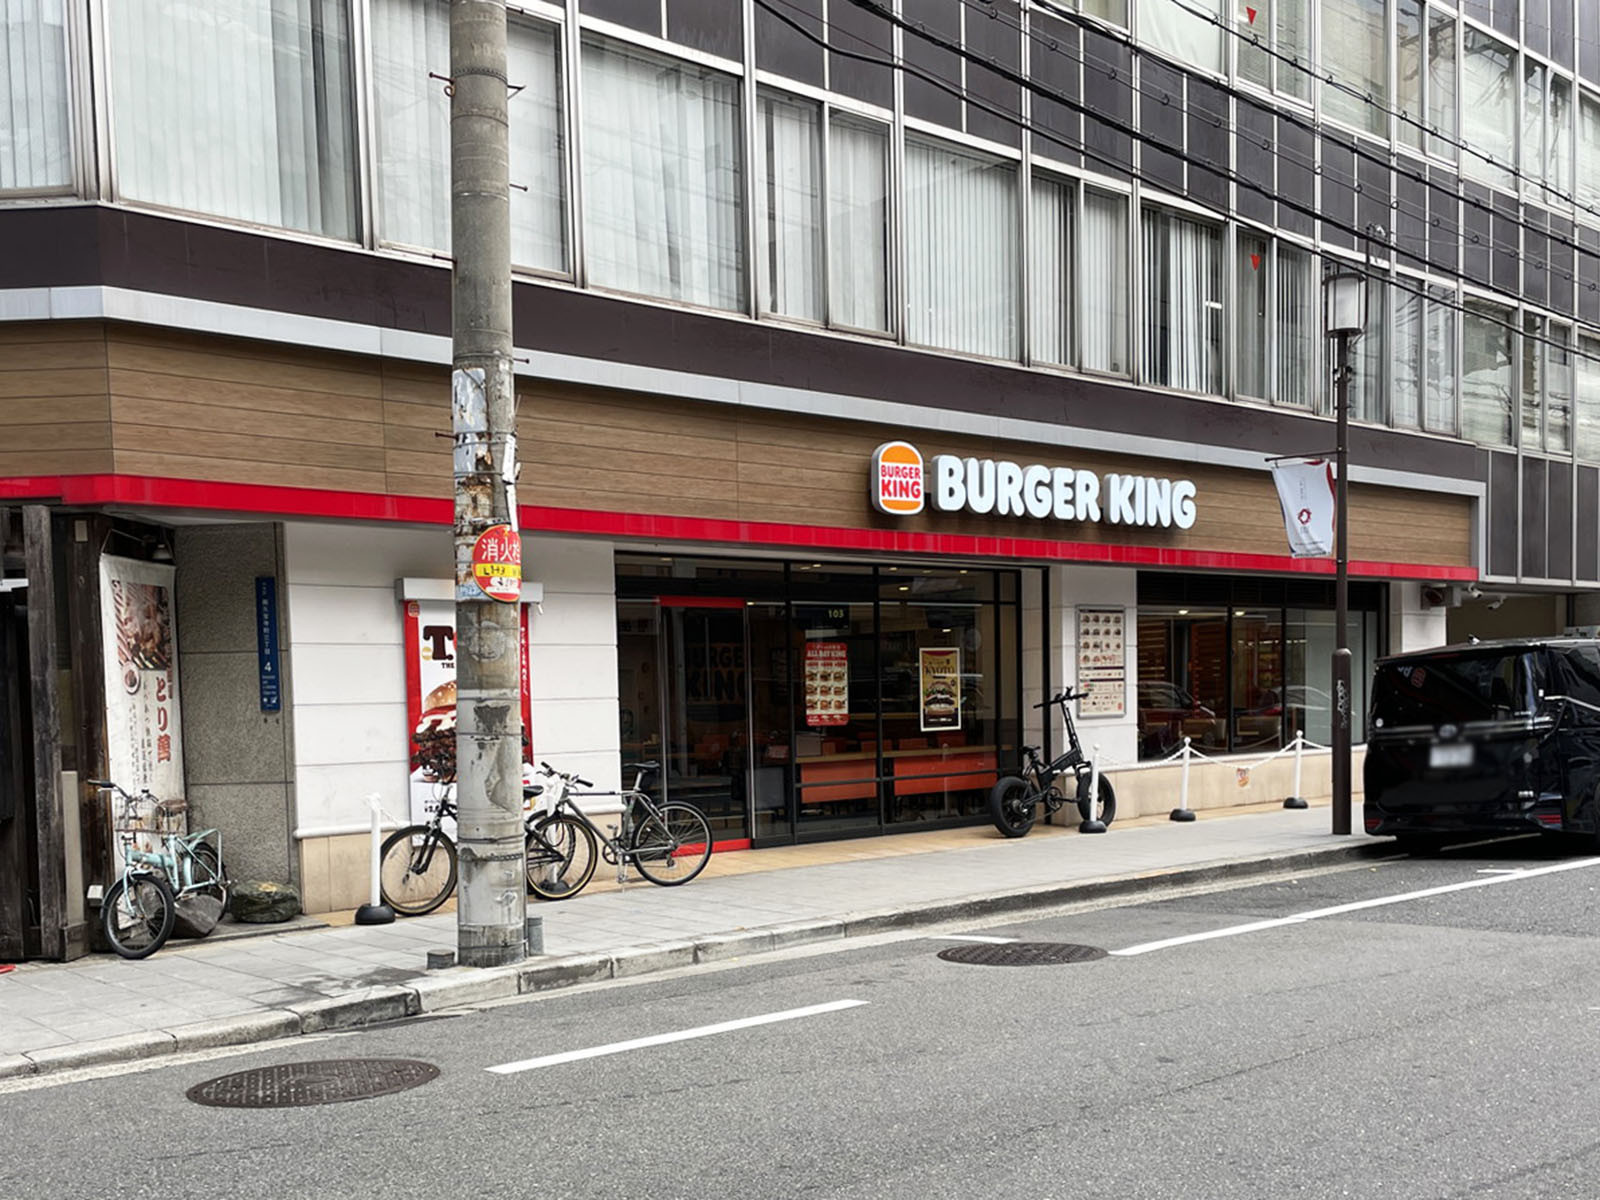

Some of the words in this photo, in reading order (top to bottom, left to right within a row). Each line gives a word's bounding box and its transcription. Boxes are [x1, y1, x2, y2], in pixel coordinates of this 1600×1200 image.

[880, 464, 921, 481] BURGER
[881, 480, 921, 499] KING
[935, 455, 1101, 523] BURGER
[1107, 473, 1197, 530] KING
[828, 609, 844, 619] 103
[264, 661, 272, 672] 4
